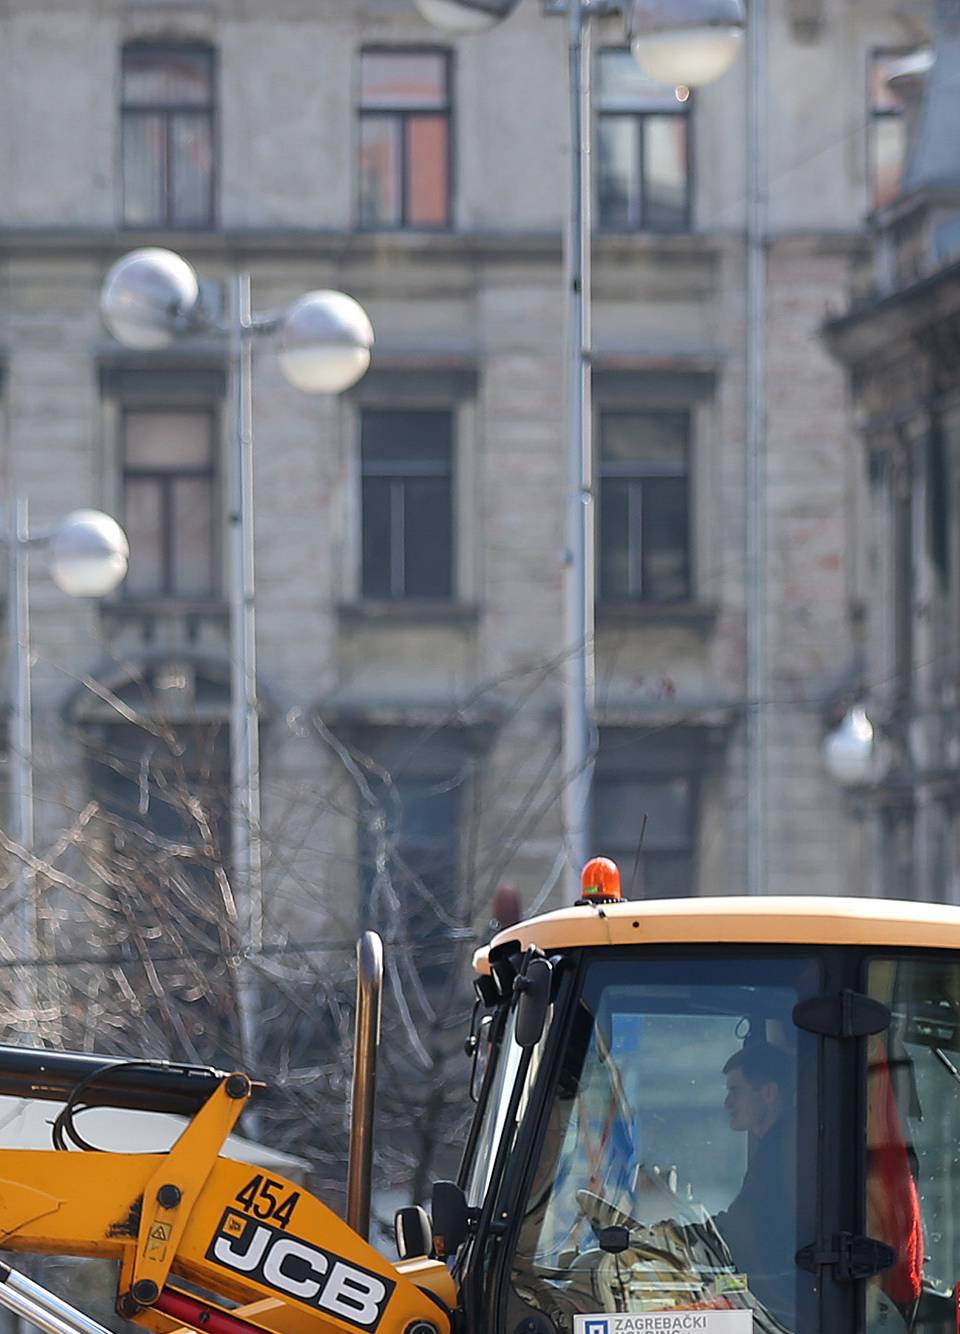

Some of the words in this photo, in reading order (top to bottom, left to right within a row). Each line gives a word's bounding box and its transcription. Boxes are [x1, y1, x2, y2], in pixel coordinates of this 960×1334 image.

[235, 1174, 301, 1229] 454
[213, 1226, 386, 1325] JCB
[615, 1314, 707, 1330] ZAGREBAČKI
